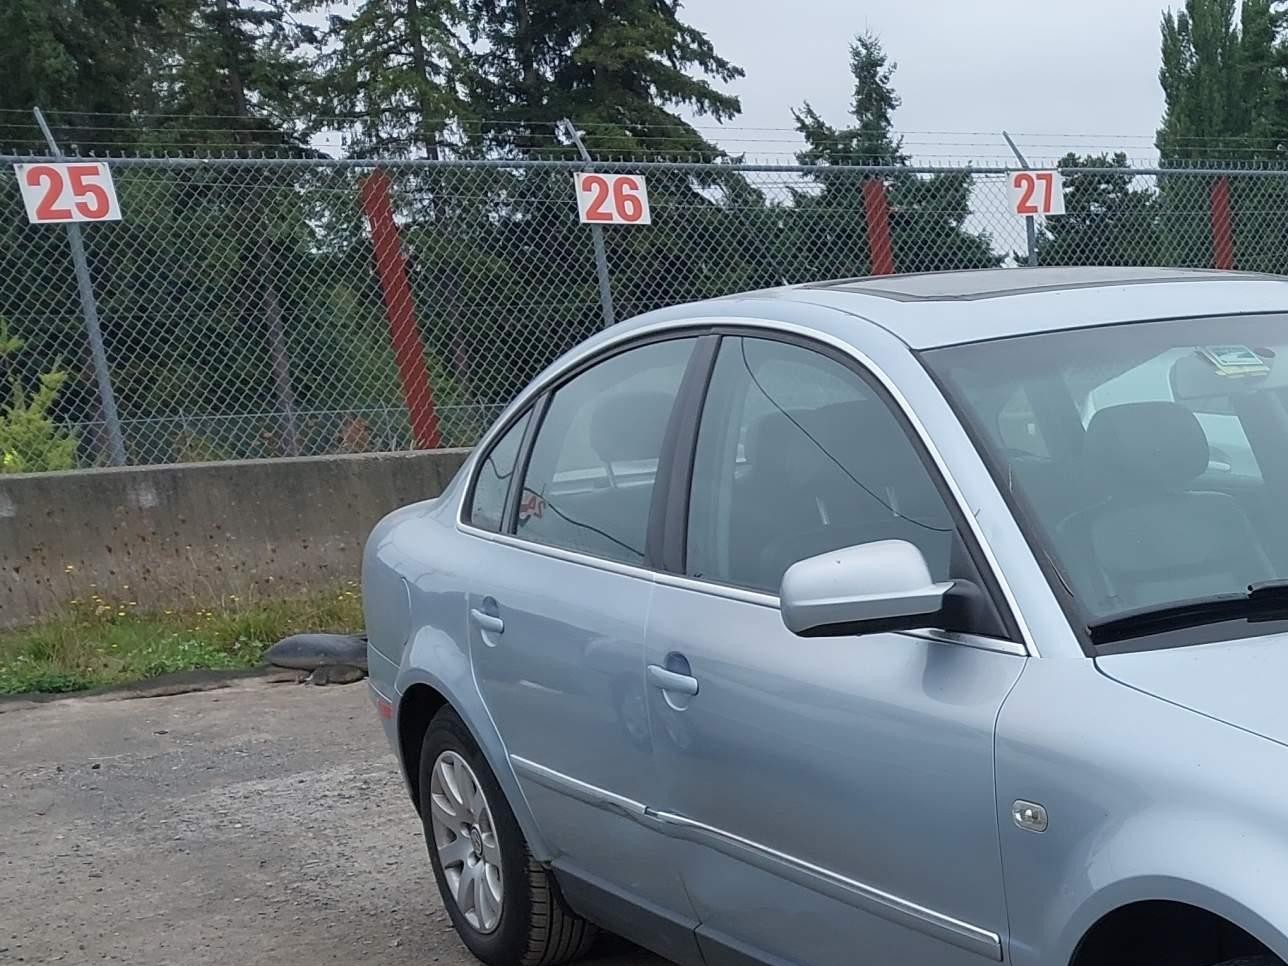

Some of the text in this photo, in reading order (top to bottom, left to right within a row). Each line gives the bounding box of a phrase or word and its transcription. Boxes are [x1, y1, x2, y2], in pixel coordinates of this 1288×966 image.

[26, 166, 109, 220] 25
[582, 175, 643, 222] 26
[1014, 172, 1053, 214] 27
